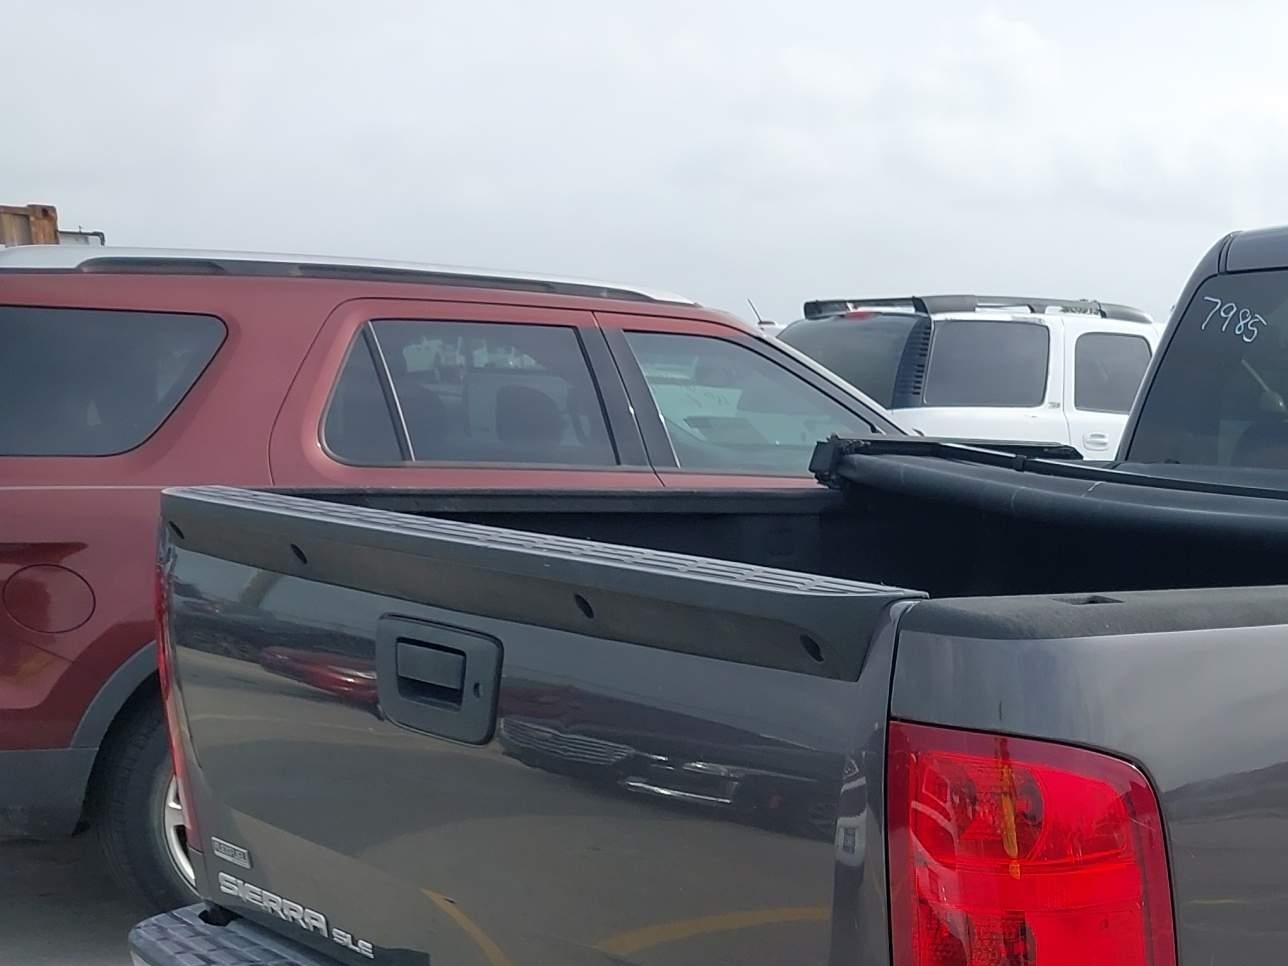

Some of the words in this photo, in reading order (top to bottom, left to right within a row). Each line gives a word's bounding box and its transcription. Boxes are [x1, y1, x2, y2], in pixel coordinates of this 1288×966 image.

[1202, 296, 1267, 342] 7985
[218, 872, 329, 937] SIERRA
[331, 927, 375, 959] SLE
